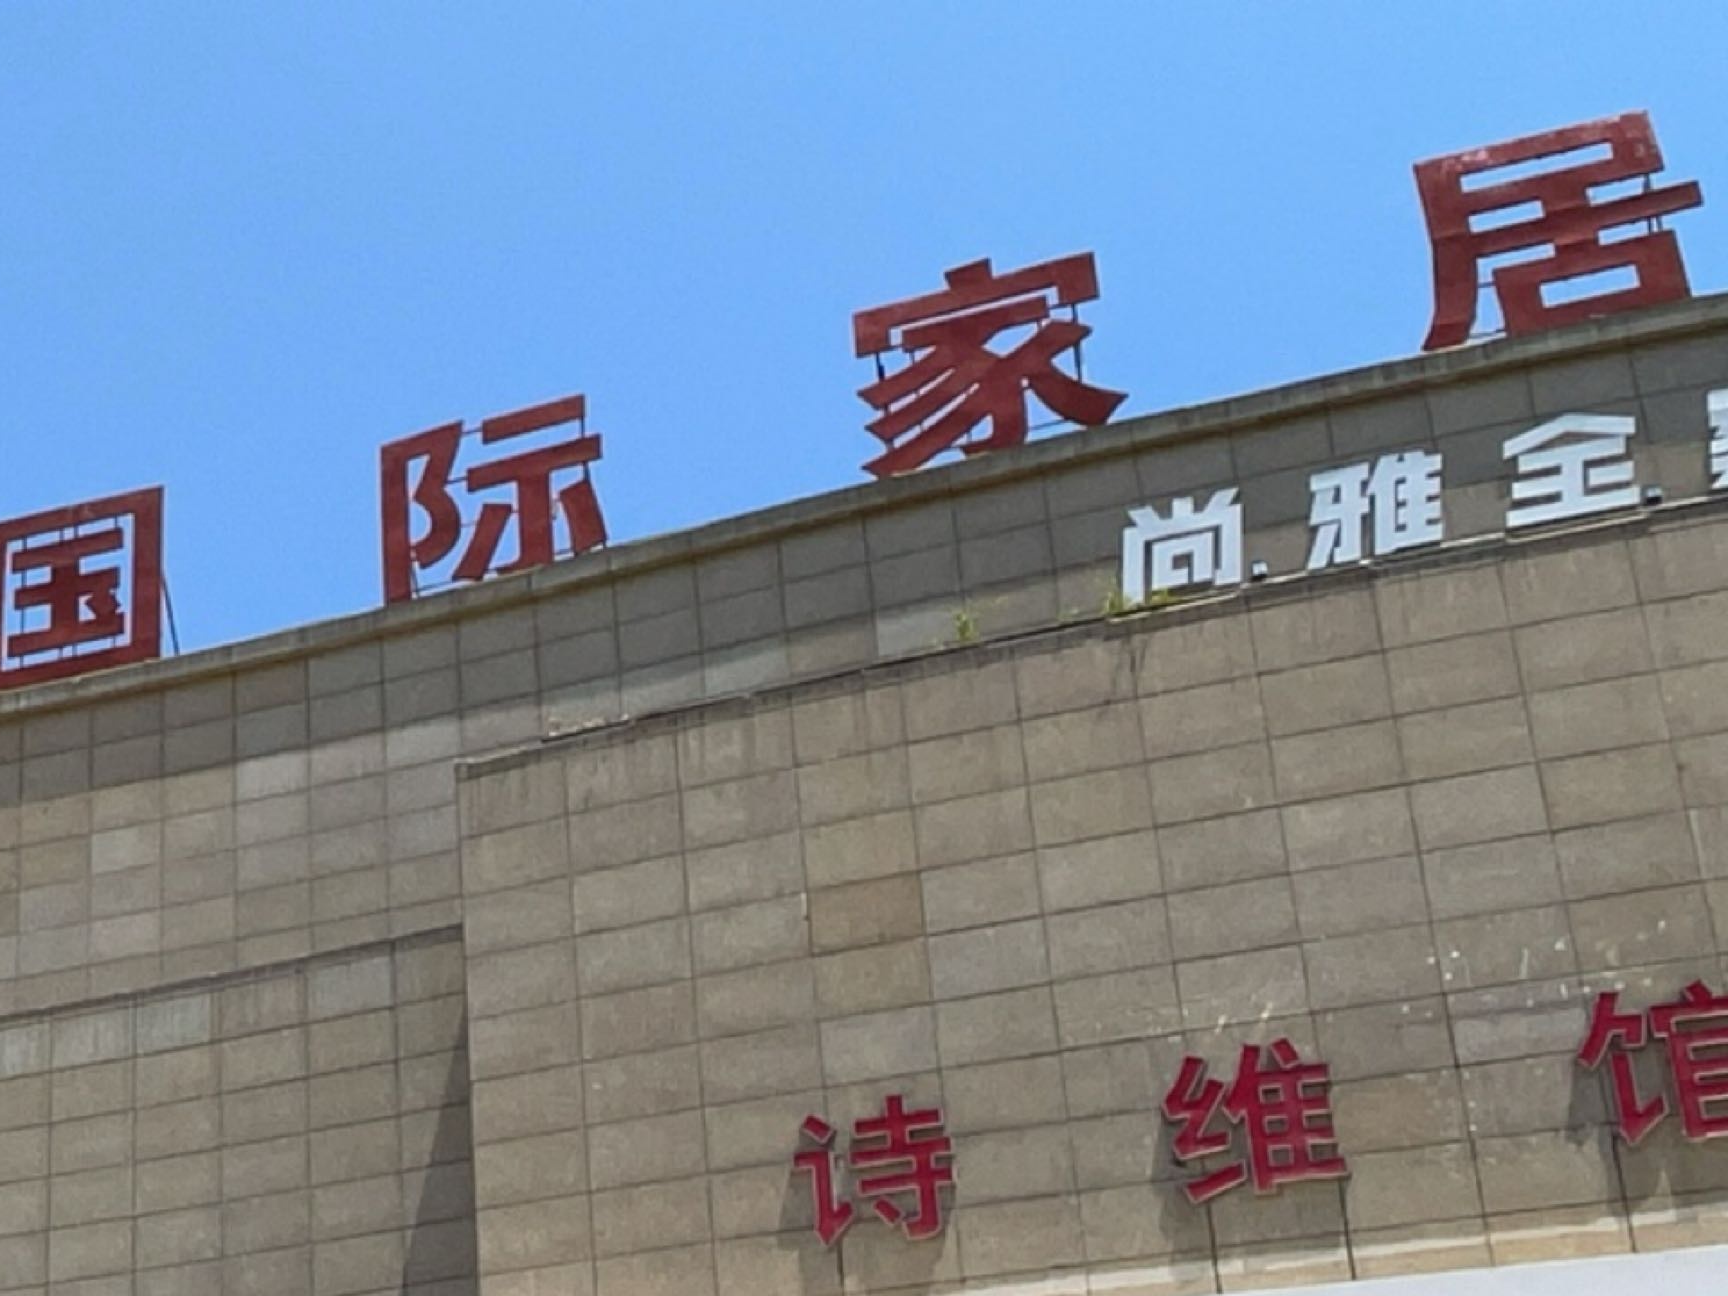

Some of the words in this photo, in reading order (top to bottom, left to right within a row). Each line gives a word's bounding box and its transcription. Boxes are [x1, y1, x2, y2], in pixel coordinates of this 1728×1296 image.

[1122, 388, 1728, 603] 尚雅全
[794, 979, 1728, 1247] 诗维馆
